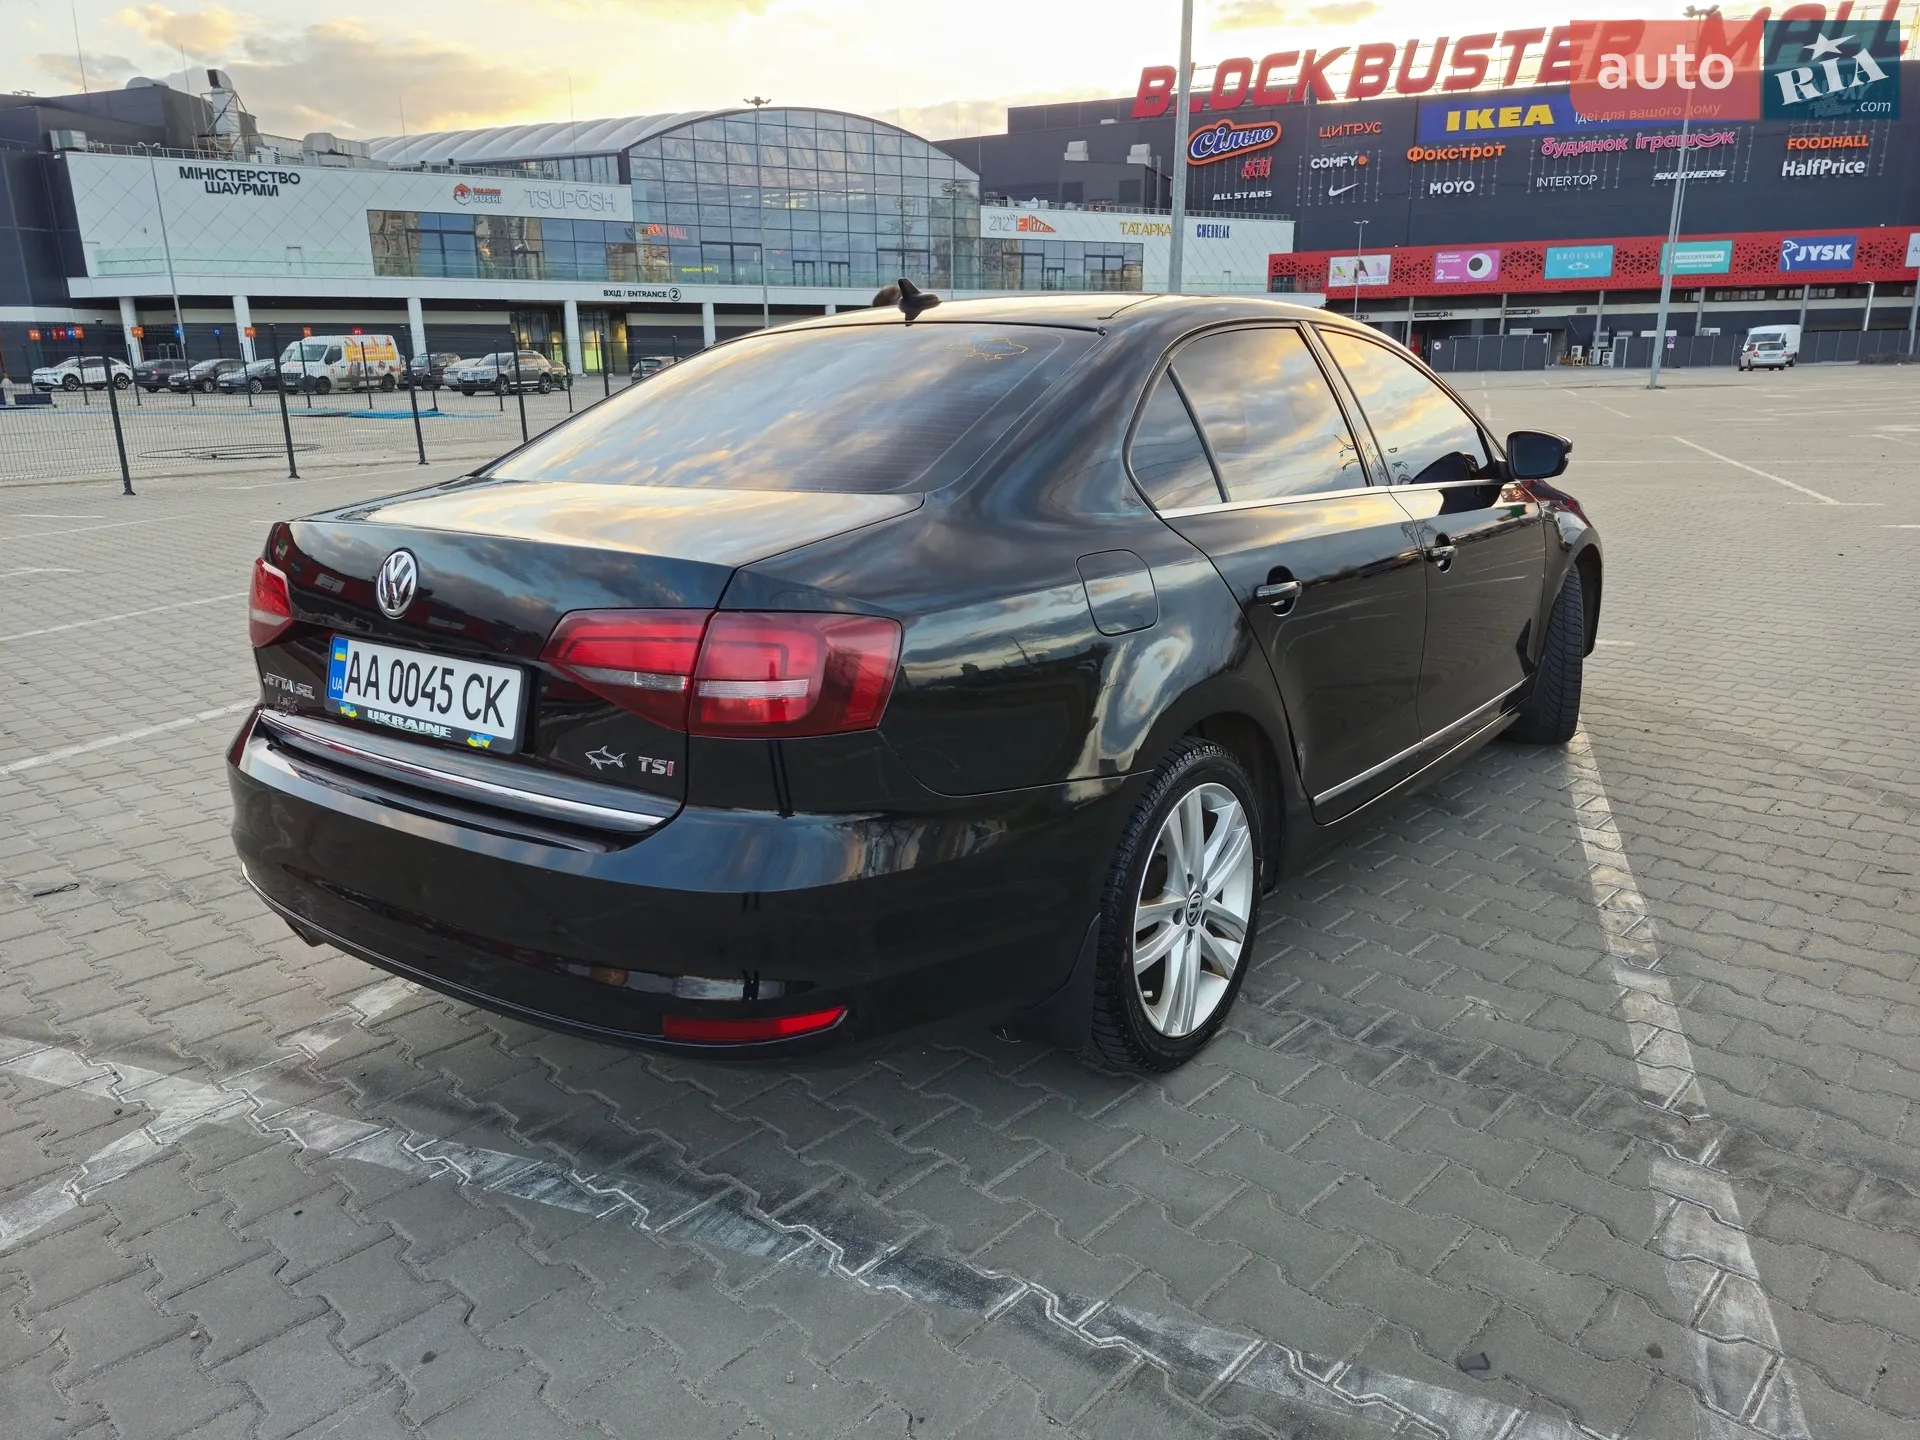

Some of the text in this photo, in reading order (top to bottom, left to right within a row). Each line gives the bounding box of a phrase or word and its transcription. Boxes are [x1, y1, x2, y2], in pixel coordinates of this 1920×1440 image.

[1446, 104, 1555, 132] IKEA
[1319, 122, 1382, 138] ЦИТРУС
[1191, 127, 1274, 158] Сільпо
[1541, 138, 1628, 158] будинок
[1787, 135, 1869, 150] FOODHALL
[1407, 144, 1506, 162] Фокстрот
[1310, 155, 1358, 169] COMFY
[1781, 158, 1866, 177] HalfPrice
[179, 165, 301, 185] МІНІСТЕРСТВО
[1536, 174, 1598, 188] INTERTOP
[205, 181, 279, 197] ШАУРМИ
[1213, 190, 1272, 201] ALL STARS
[1429, 180, 1475, 195] MOYO
[473, 195, 502, 204] SUSHI
[1795, 244, 1852, 261] JYSK
[603, 289, 622, 297] ВХІД
[628, 290, 667, 298] ENTRANCE
[263, 672, 293, 693] JETTA
[332, 676, 343, 691] UA
[345, 651, 510, 727] AA 0045 CK
[367, 709, 452, 738] UKRAINE
[638, 756, 675, 776] TSI
